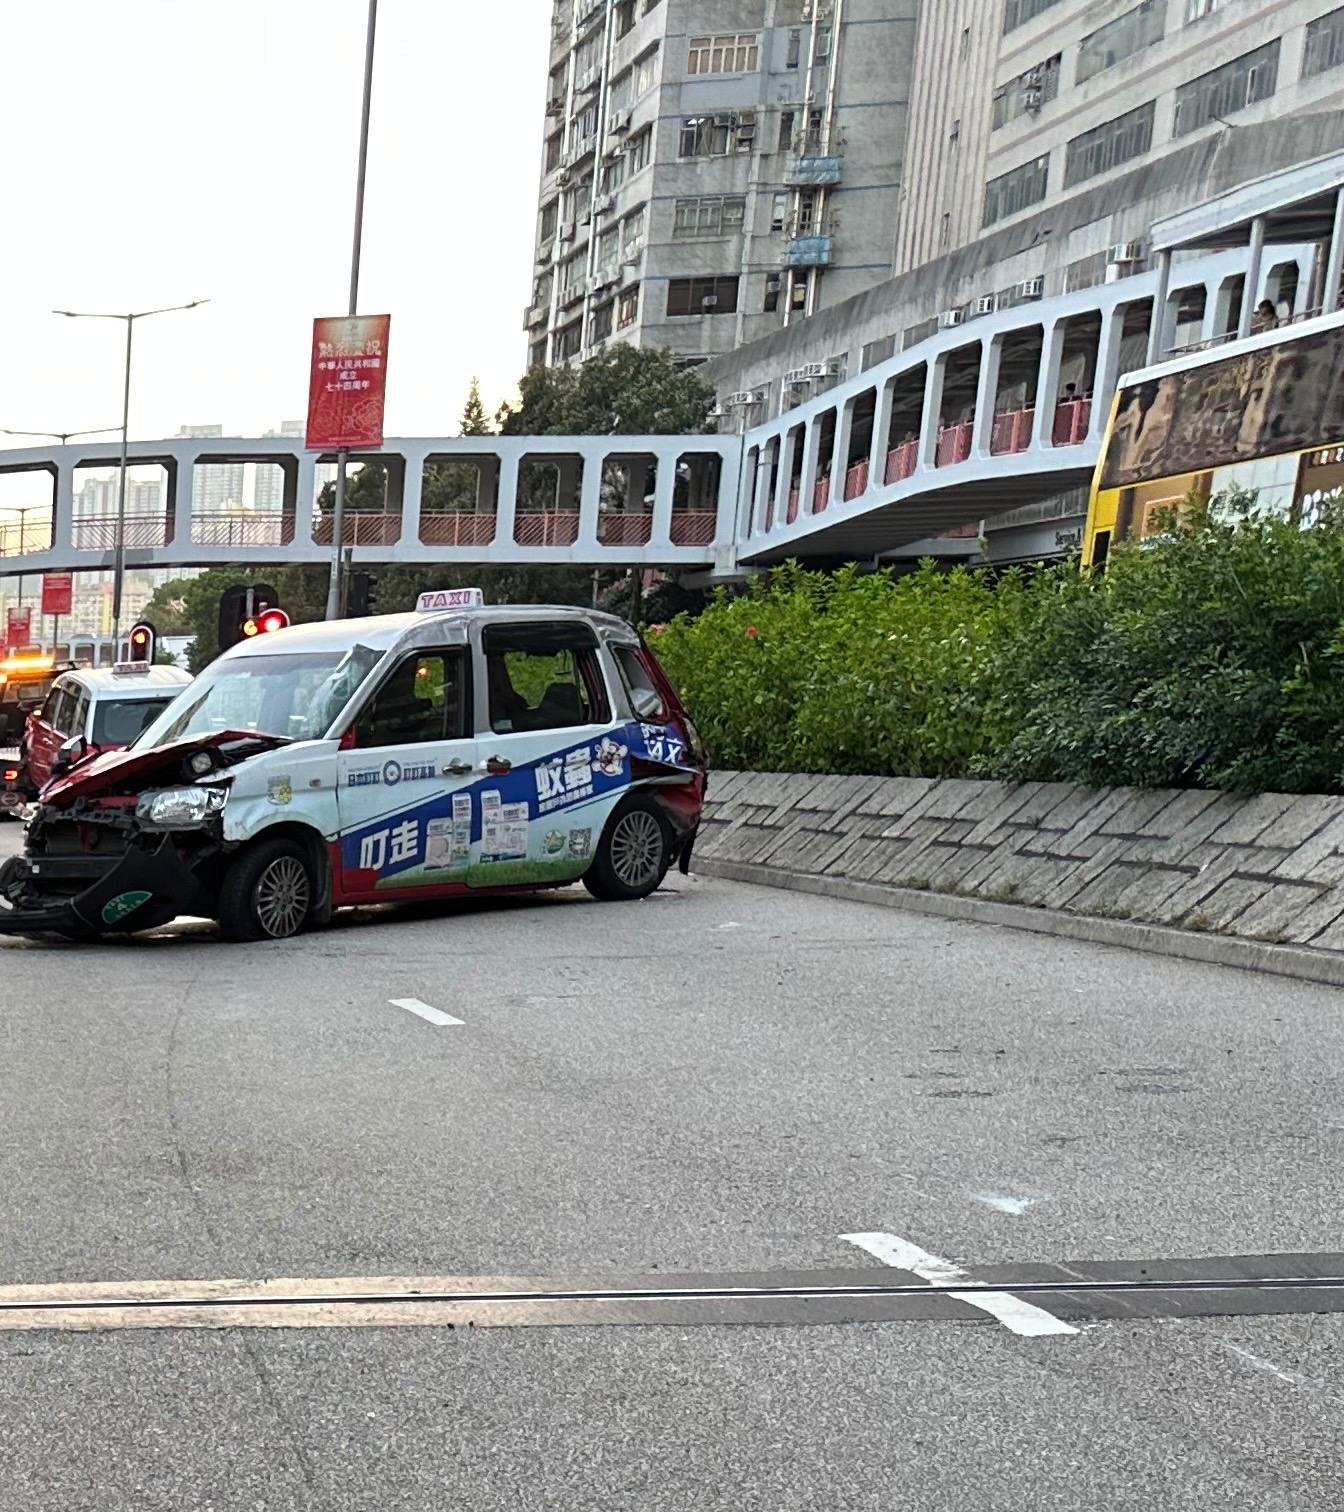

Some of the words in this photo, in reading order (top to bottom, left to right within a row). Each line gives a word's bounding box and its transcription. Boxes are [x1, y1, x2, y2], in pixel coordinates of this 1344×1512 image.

[318, 358, 380, 370] 中華人民共和國
[339, 370, 357, 380] 成立
[421, 591, 471, 608] TAXI
[360, 820, 419, 870] 叮走
